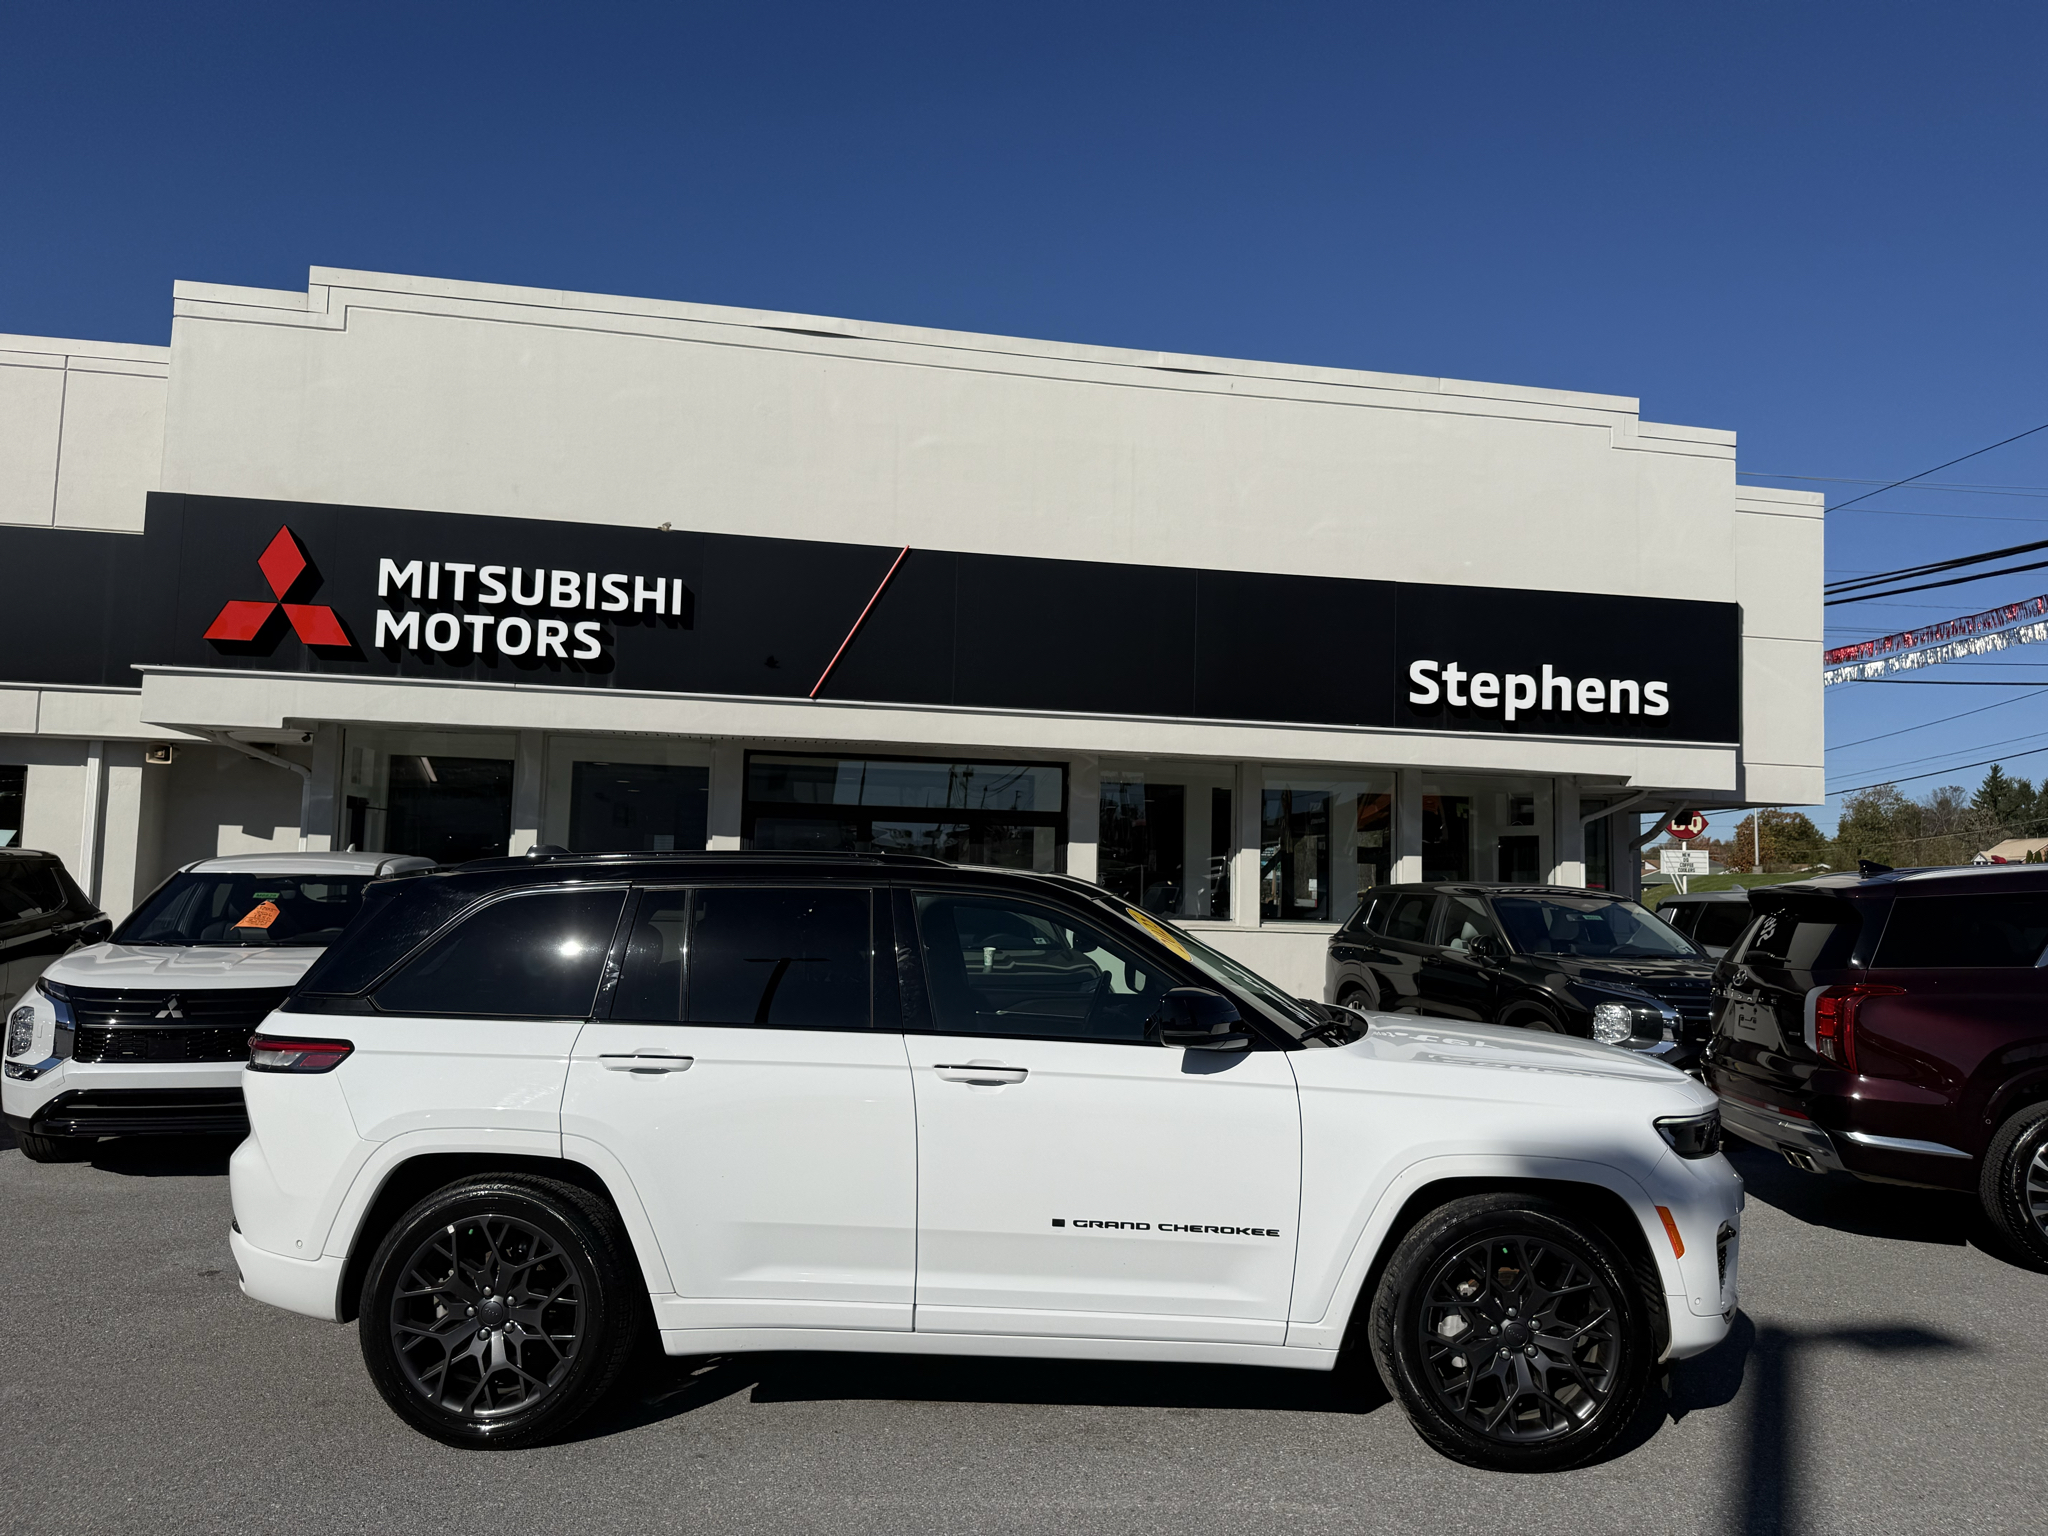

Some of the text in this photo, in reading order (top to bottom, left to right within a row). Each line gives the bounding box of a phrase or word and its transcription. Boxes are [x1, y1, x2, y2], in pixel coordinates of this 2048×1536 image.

[378, 558, 683, 616] MITSUBISHI
[375, 609, 602, 660] MOTORS
[1409, 660, 1670, 721] Stephens
[1072, 1219, 1281, 1238] GRAND CHEROKEE
